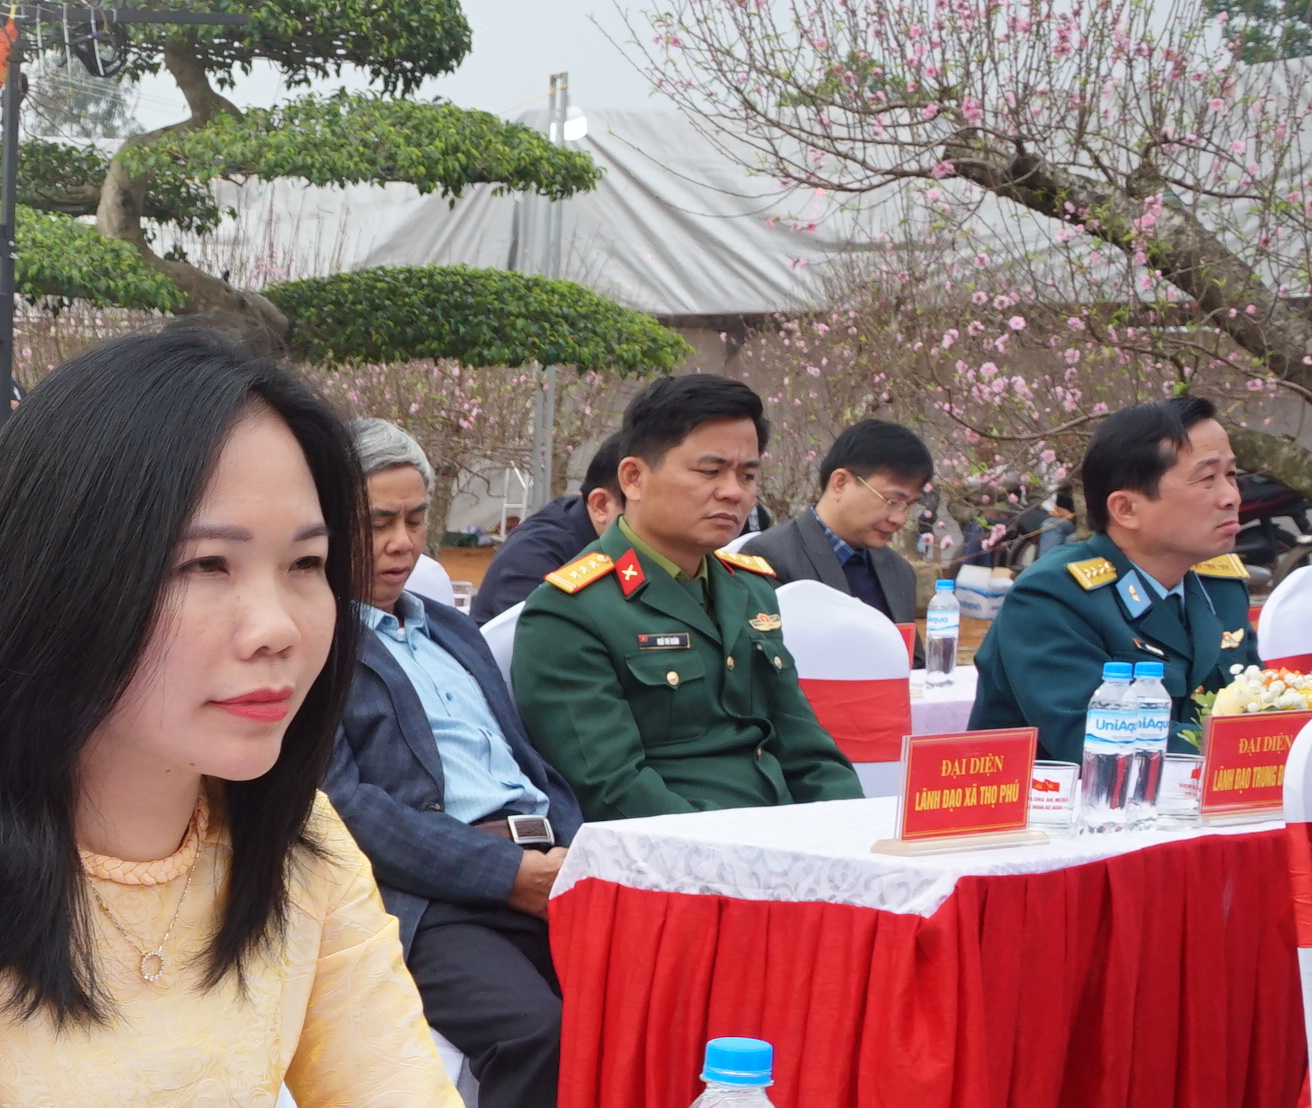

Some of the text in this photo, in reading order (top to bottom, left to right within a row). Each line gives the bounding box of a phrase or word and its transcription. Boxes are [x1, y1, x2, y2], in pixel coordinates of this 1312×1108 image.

[1239, 737, 1262, 756] ĐẠI
[941, 753, 1004, 779] ĐẠI DIỆN
[915, 779, 1020, 812] LÃNH ĐẠO XÃ THỌ PHÚ
